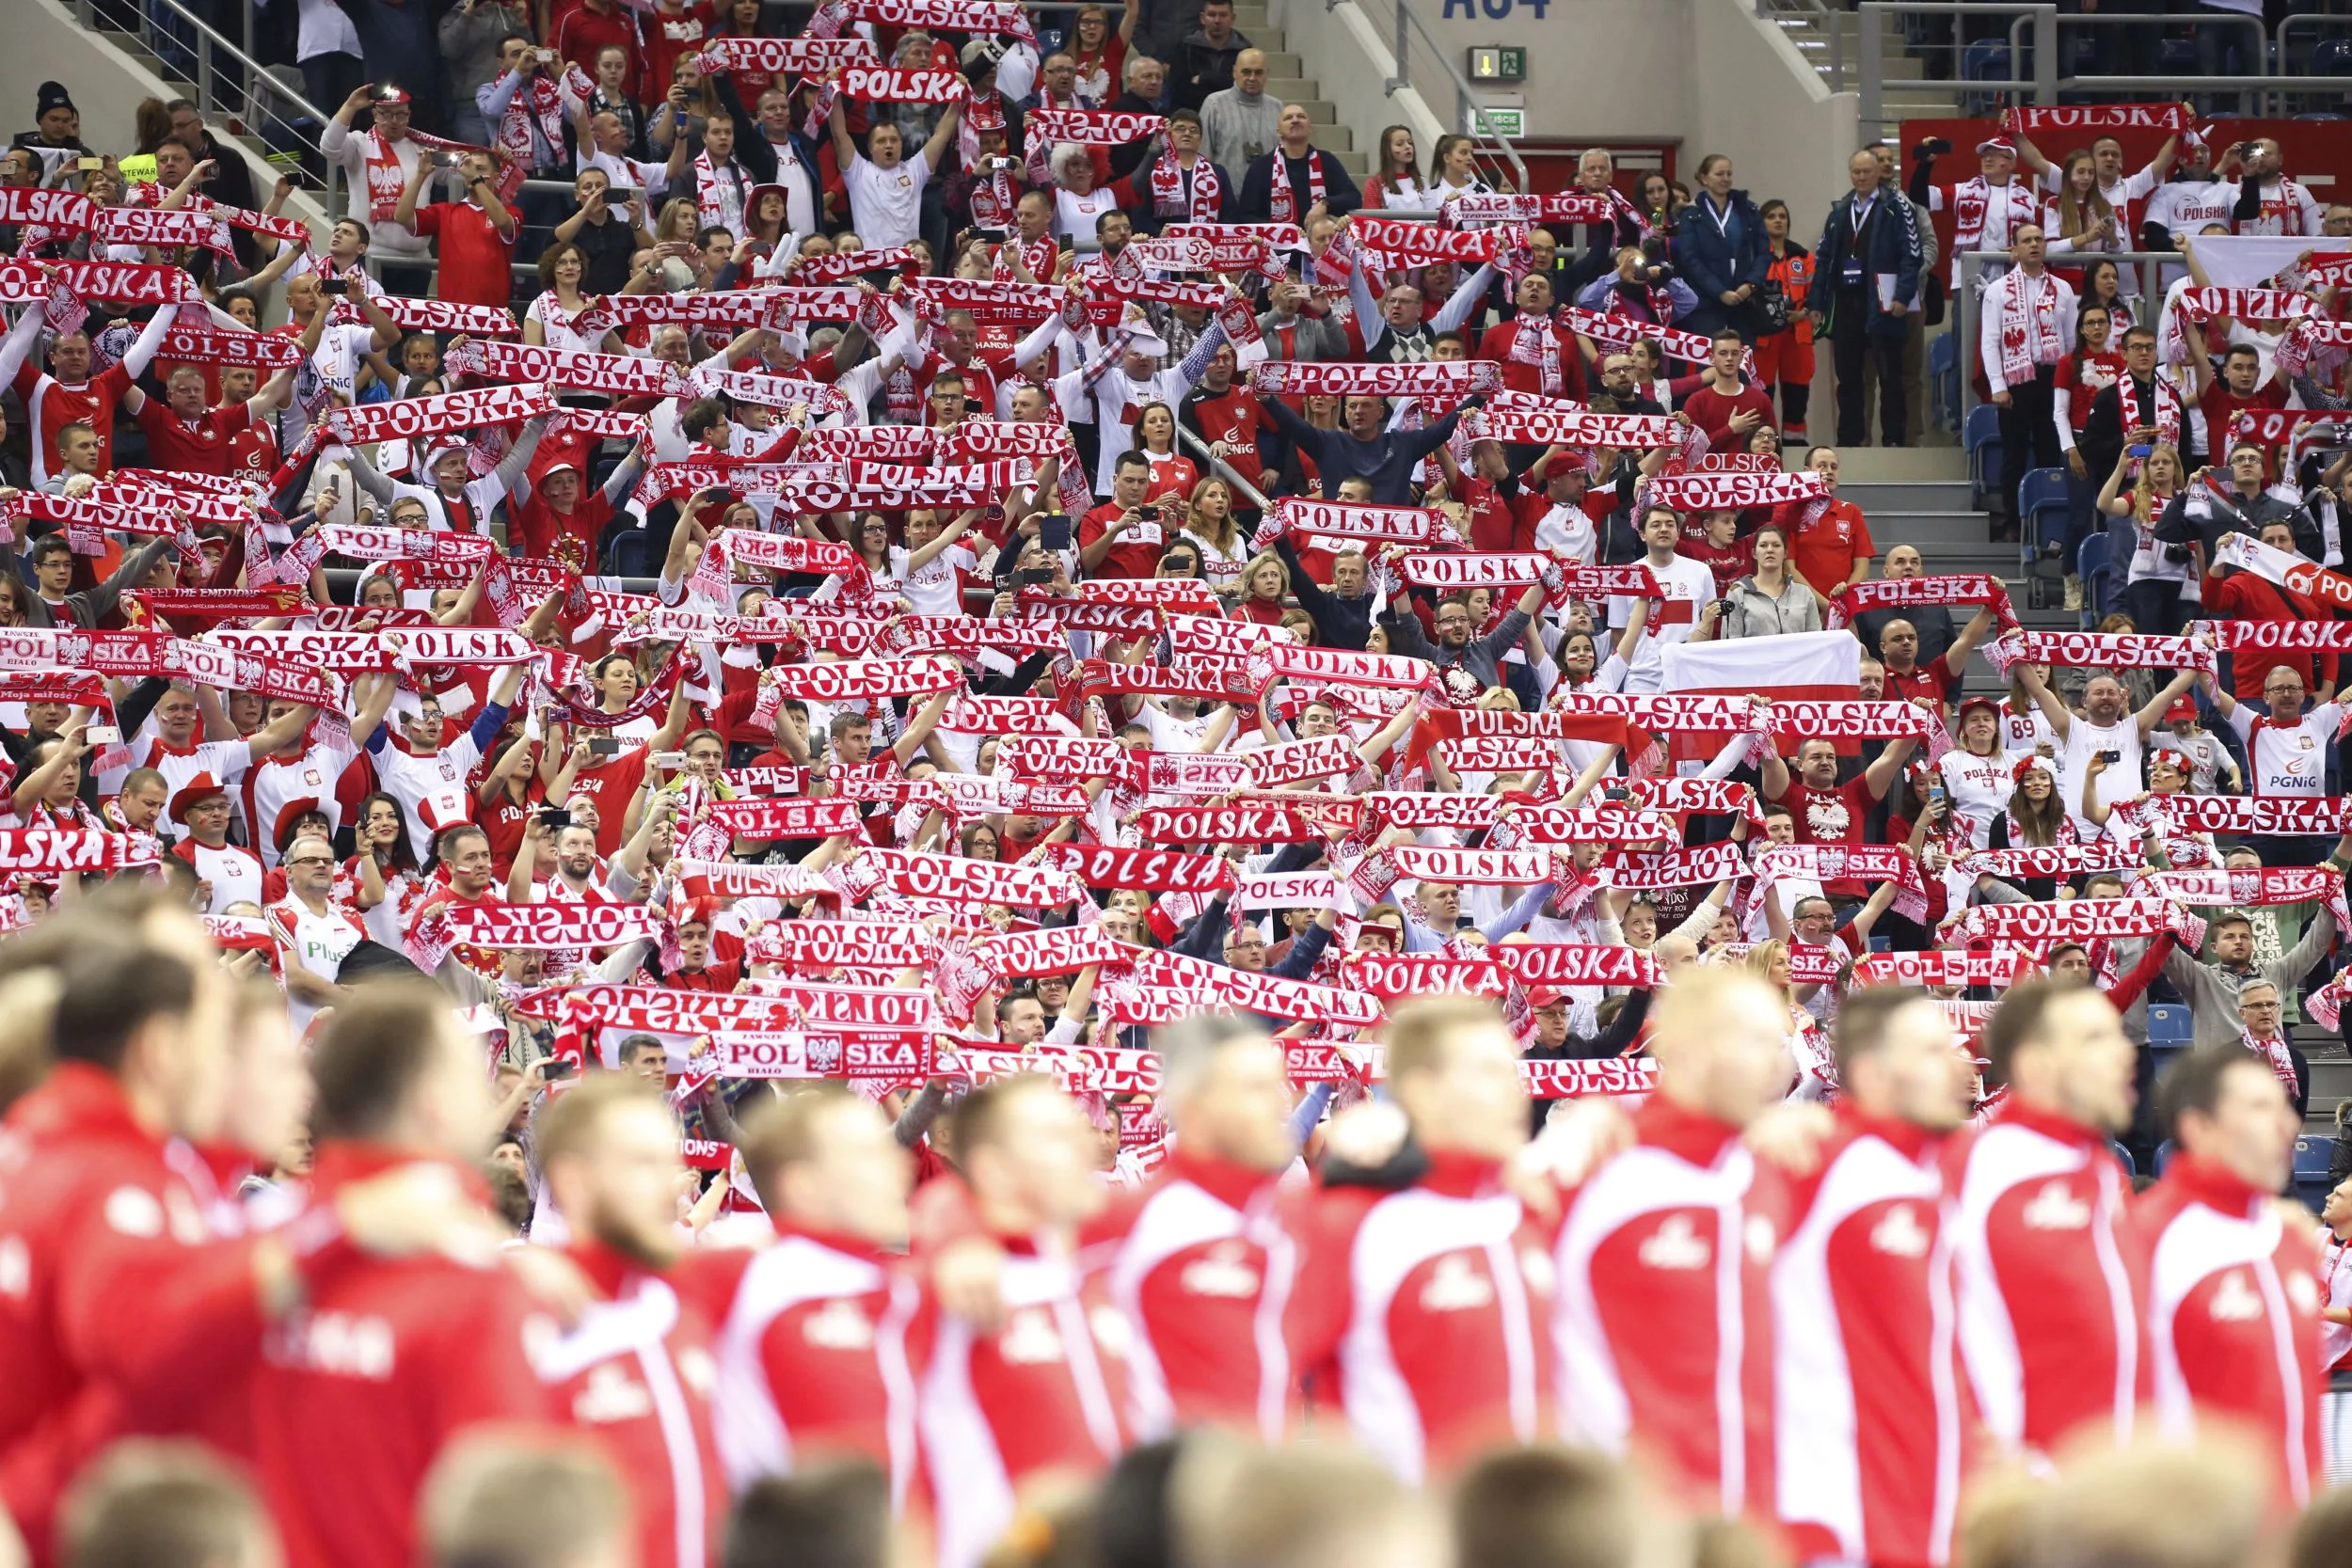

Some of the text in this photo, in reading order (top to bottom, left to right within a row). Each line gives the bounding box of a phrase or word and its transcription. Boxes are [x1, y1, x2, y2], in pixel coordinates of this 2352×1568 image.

[739, 40, 882, 73] POLSKA
[846, 69, 964, 99] POLSKA
[2028, 106, 2180, 130] POLSKA
[1363, 219, 1485, 257] POLSKA
[1214, 244, 1258, 261] SKA
[621, 296, 755, 324] POLSKA
[925, 284, 1057, 309] POLSKA
[993, 309, 1024, 320] THE
[166, 334, 303, 360] OLSKA
[986, 333, 1009, 342] PLAY
[497, 346, 650, 395] POLSKA
[1296, 365, 1456, 394] POLSKA
[367, 383, 537, 440] POLSKA
[810, 426, 934, 458] POLSKA
[1502, 412, 1658, 446] POLSKA
[743, 437, 754, 456] 8
[669, 471, 729, 488] POL
[856, 462, 986, 486] POLSKA
[1660, 471, 1808, 509] POLSKA
[22, 494, 177, 534] POLSKA
[1292, 505, 1422, 537] POLSKA
[335, 531, 399, 551] POL
[909, 570, 951, 585] POLSKA
[1417, 558, 1544, 587] POLSKA
[1568, 570, 1645, 590] SKA
[172, 587, 199, 598] THE
[1853, 580, 1992, 604] POLSKA
[661, 611, 709, 630] POL
[739, 618, 789, 633] SKA
[1027, 602, 1157, 631] POLSKA
[103, 634, 139, 642] WIERNI
[930, 618, 1066, 649] POLSKA
[91, 641, 151, 663] SKA
[219, 635, 383, 668] POLSKA
[2037, 632, 2197, 667] POLSKA
[94, 662, 151, 672] CZERWONYM
[277, 660, 310, 673] WIERNI
[787, 659, 958, 697] POLSKA
[1110, 663, 1225, 692] POLSKA
[1282, 649, 1423, 683] POLSKA
[266, 667, 322, 695] SKA
[1458, 710, 1564, 737] POLSKA
[1573, 694, 1738, 731] POLSKA
[1772, 702, 1916, 736] POLSKA
[2010, 719, 2036, 741] 89
[1015, 737, 1130, 778] POLSKA
[1963, 768, 2009, 781] POLSKA
[2270, 776, 2317, 788] PGNiG
[1028, 786, 1089, 806] SKA
[1150, 811, 1293, 839] POLSKA
[1371, 797, 1502, 826] POLSKA
[2178, 797, 2341, 834] POLSKA
[1060, 847, 1224, 888] POLSKA
[1410, 849, 1549, 879] POLSKA
[1847, 853, 1900, 874] SKA
[882, 851, 1055, 907] POLSKA
[2264, 872, 2327, 893] SKA
[1994, 898, 2154, 939] POLSKA
[792, 922, 921, 965] POLSKA
[993, 924, 1119, 974] POLSKA
[1361, 959, 1505, 997] POLSKA
[1874, 958, 2013, 980] POLSKA
[858, 1033, 901, 1042] WIERNI
[728, 1042, 911, 1067] POL SKA
